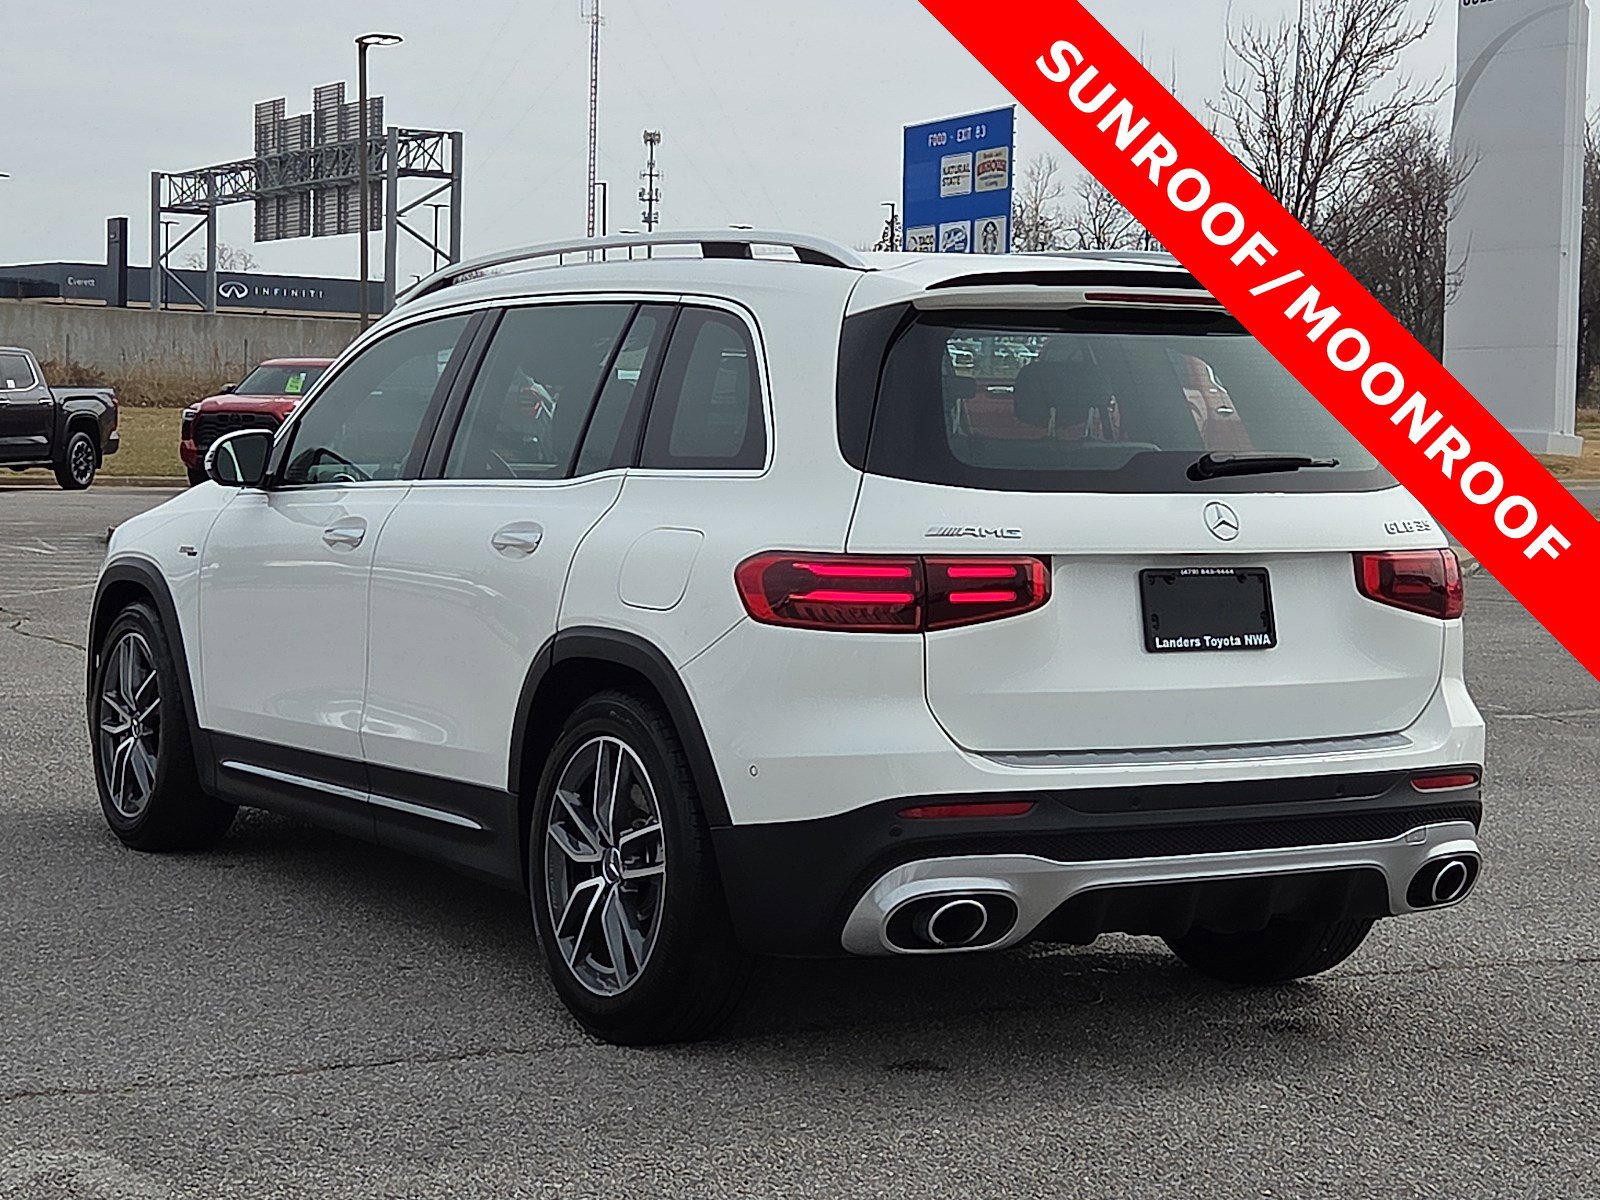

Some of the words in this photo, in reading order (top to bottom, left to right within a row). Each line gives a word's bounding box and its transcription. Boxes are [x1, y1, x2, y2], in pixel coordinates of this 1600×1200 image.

[927, 131, 948, 147] FOOD
[956, 126, 973, 142] EXIT
[942, 163, 971, 176] NATURAL
[942, 175, 961, 187] STATE
[67, 276, 96, 288] Everett
[254, 286, 324, 299] INFINITI
[959, 526, 1023, 540] AMG
[1384, 521, 1414, 535] GLB
[1155, 636, 1202, 649] Landers
[1203, 635, 1242, 649] Toyota
[1244, 634, 1272, 646] NWA
